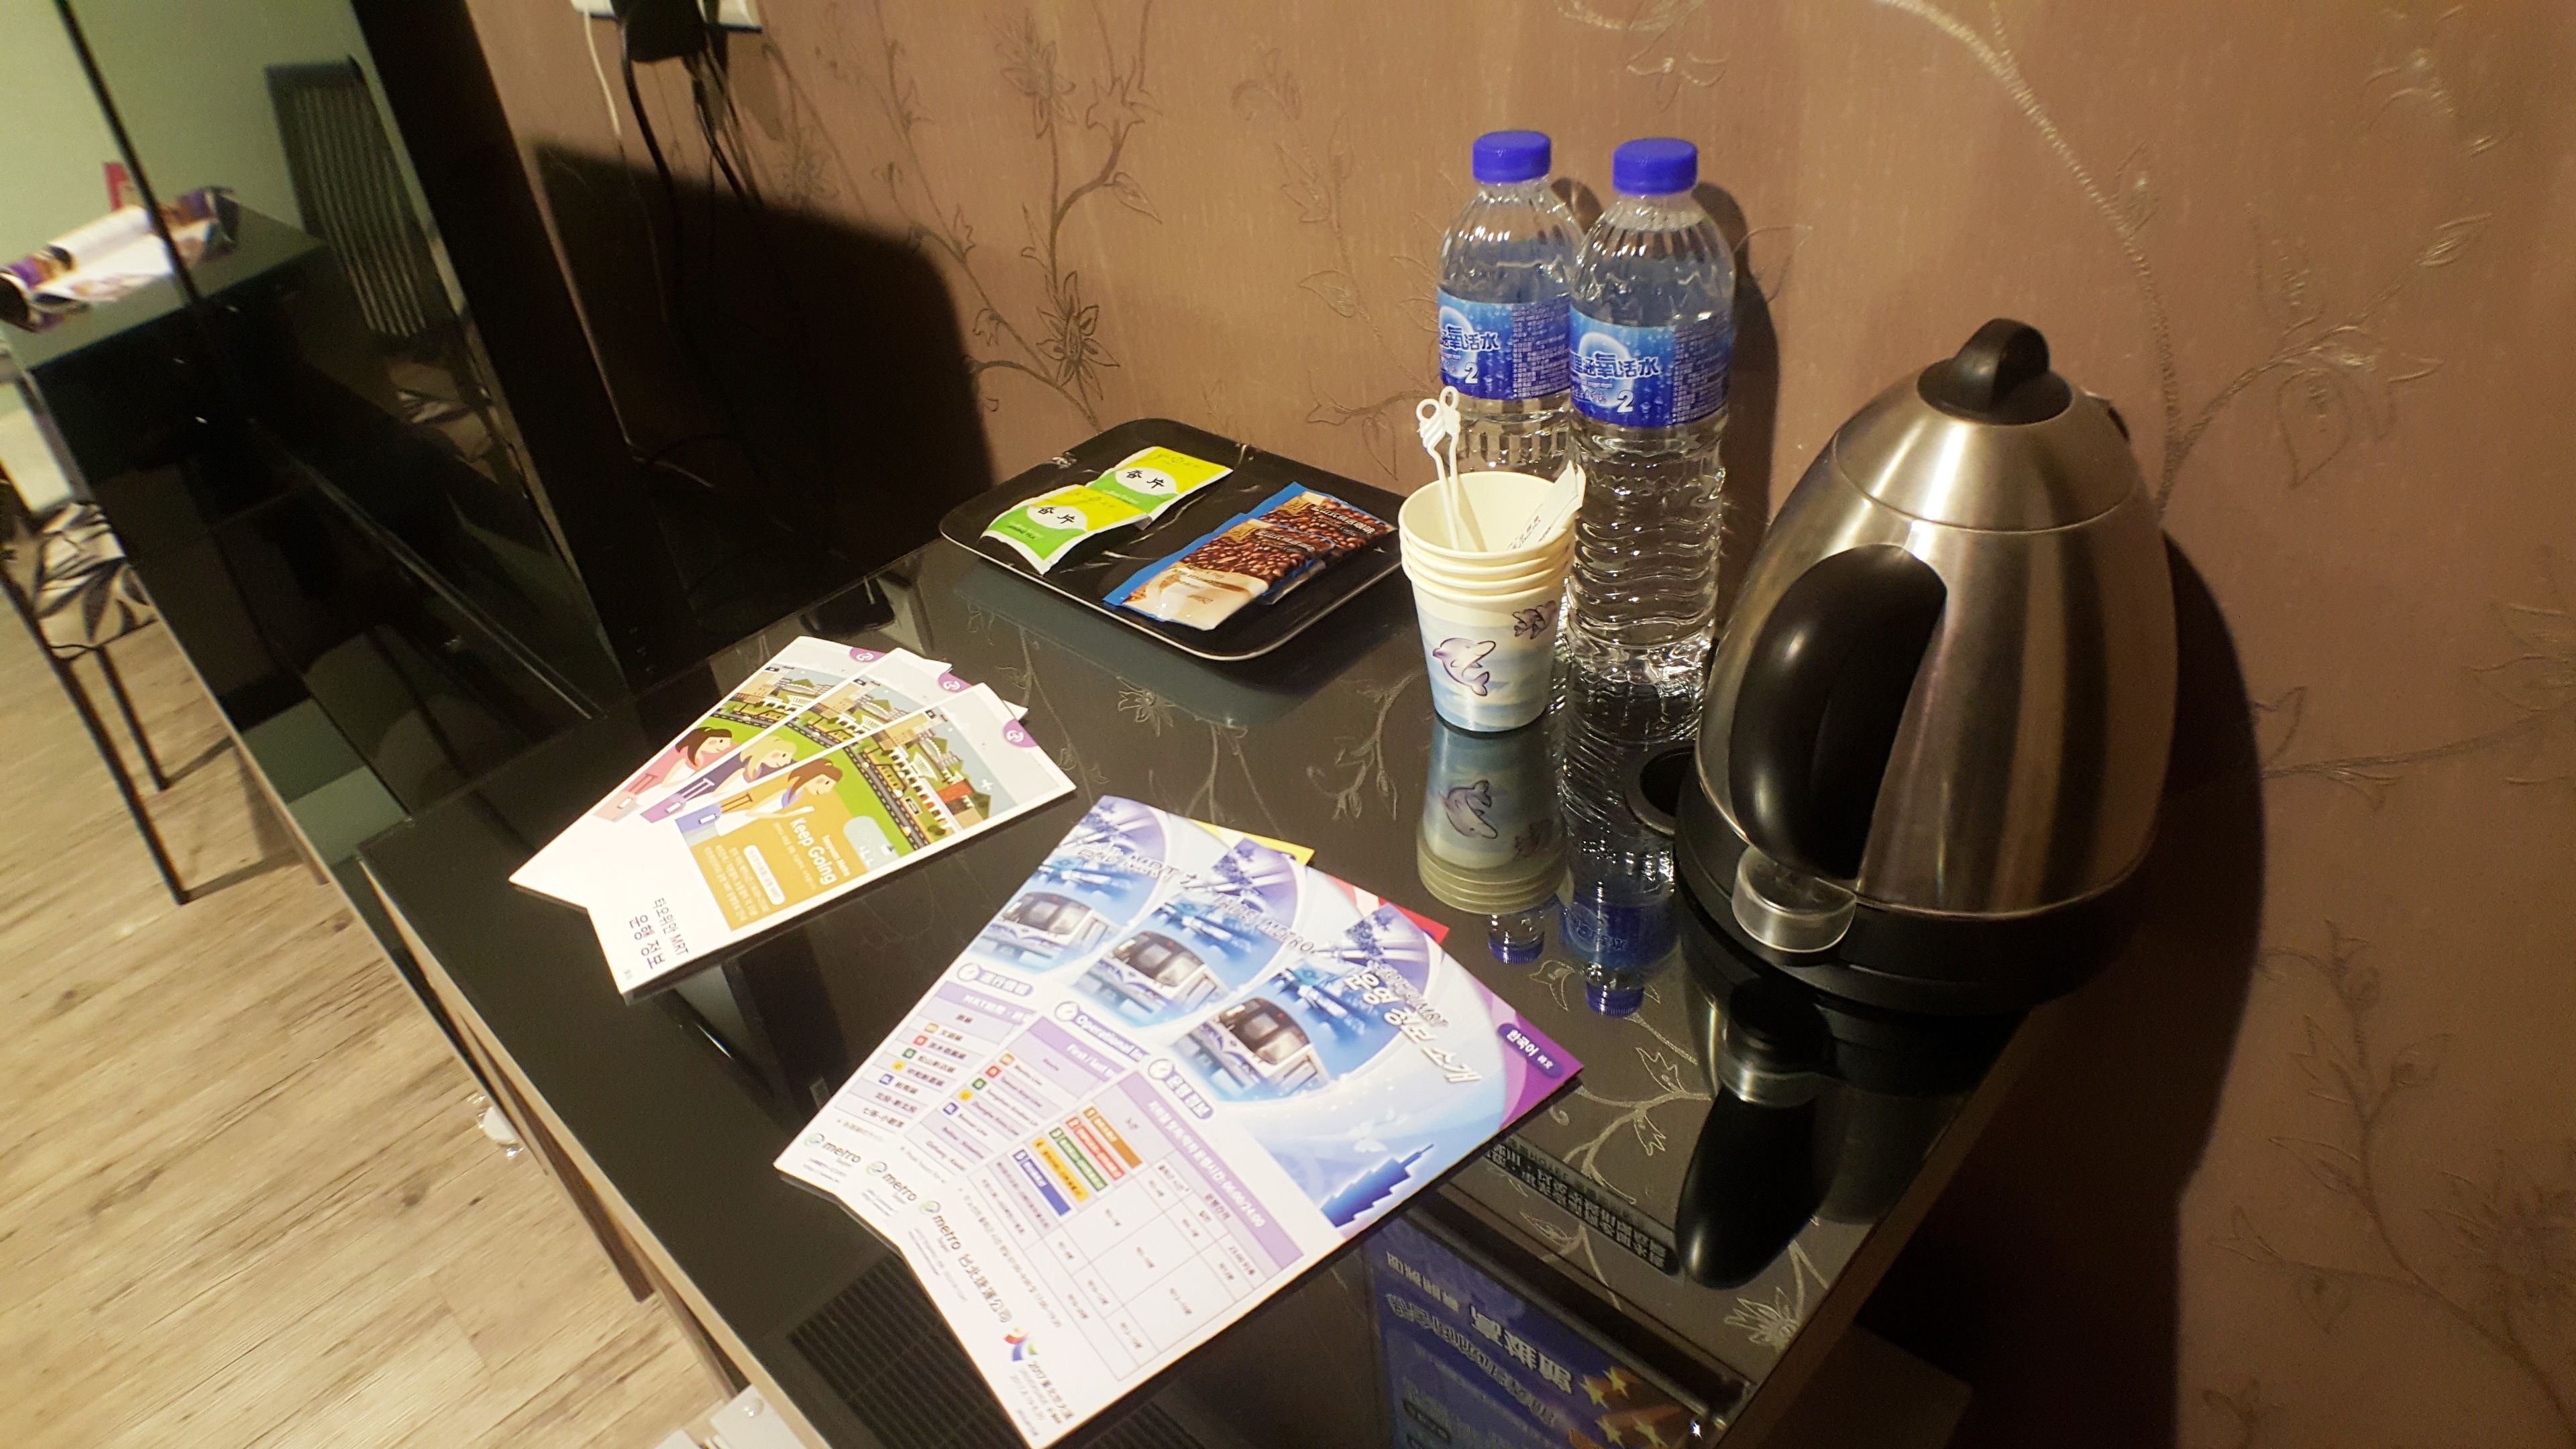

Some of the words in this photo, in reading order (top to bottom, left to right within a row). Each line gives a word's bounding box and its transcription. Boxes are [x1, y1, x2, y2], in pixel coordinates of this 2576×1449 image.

[1126, 470, 1165, 489] 香片
[1038, 506, 1075, 525] 香片
[790, 817, 814, 849] Keep
[807, 844, 837, 887] Going
[1123, 853, 1179, 878] MRT
[629, 914, 653, 940] 운행
[641, 940, 665, 969] 정보
[654, 898, 678, 934] 타오위안
[672, 934, 688, 955] MRT
[1258, 918, 1315, 955] METRO
[1073, 1014, 1134, 1054] Operational
[1343, 971, 1401, 1006] 운영
[1383, 1007, 1436, 1044] 정보
[1421, 1046, 1483, 1083] 소개
[1504, 1028, 1540, 1055] 한국어
[1065, 1042, 1091, 1059] First
[820, 1140, 862, 1165] metro
[883, 1173, 916, 1201] metro
[933, 1212, 962, 1252] metro
